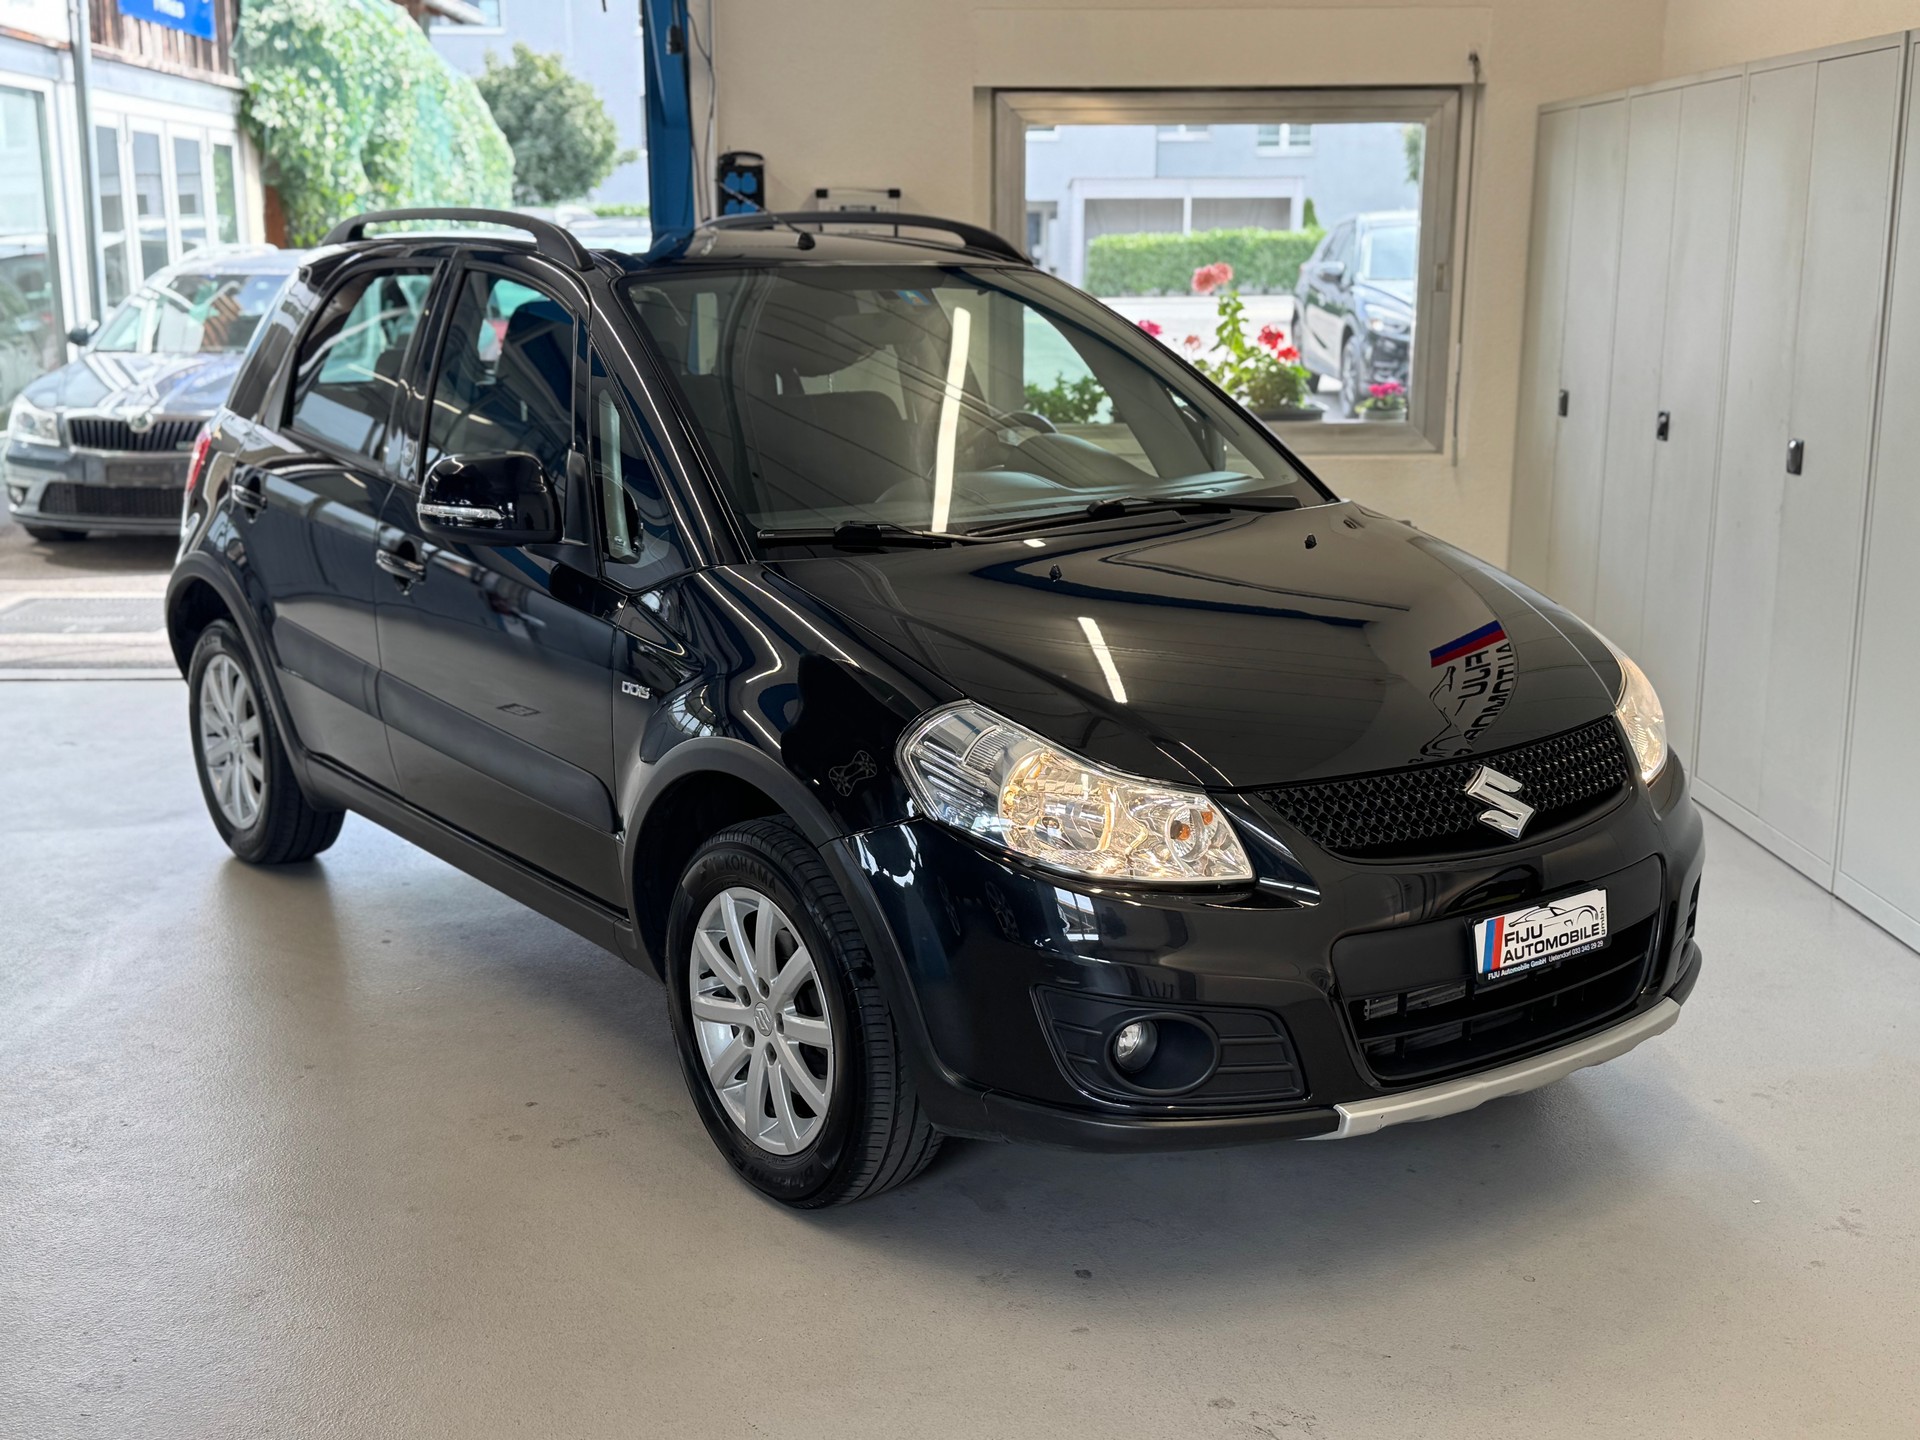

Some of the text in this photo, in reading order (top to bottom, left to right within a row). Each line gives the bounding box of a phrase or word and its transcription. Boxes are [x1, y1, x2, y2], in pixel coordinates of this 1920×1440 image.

[1503, 923, 1543, 948] FIJU
[1503, 922, 1600, 964] AUTOMOBILE
[1501, 963, 1530, 977] Automobile
[1530, 957, 1547, 969] GmbH
